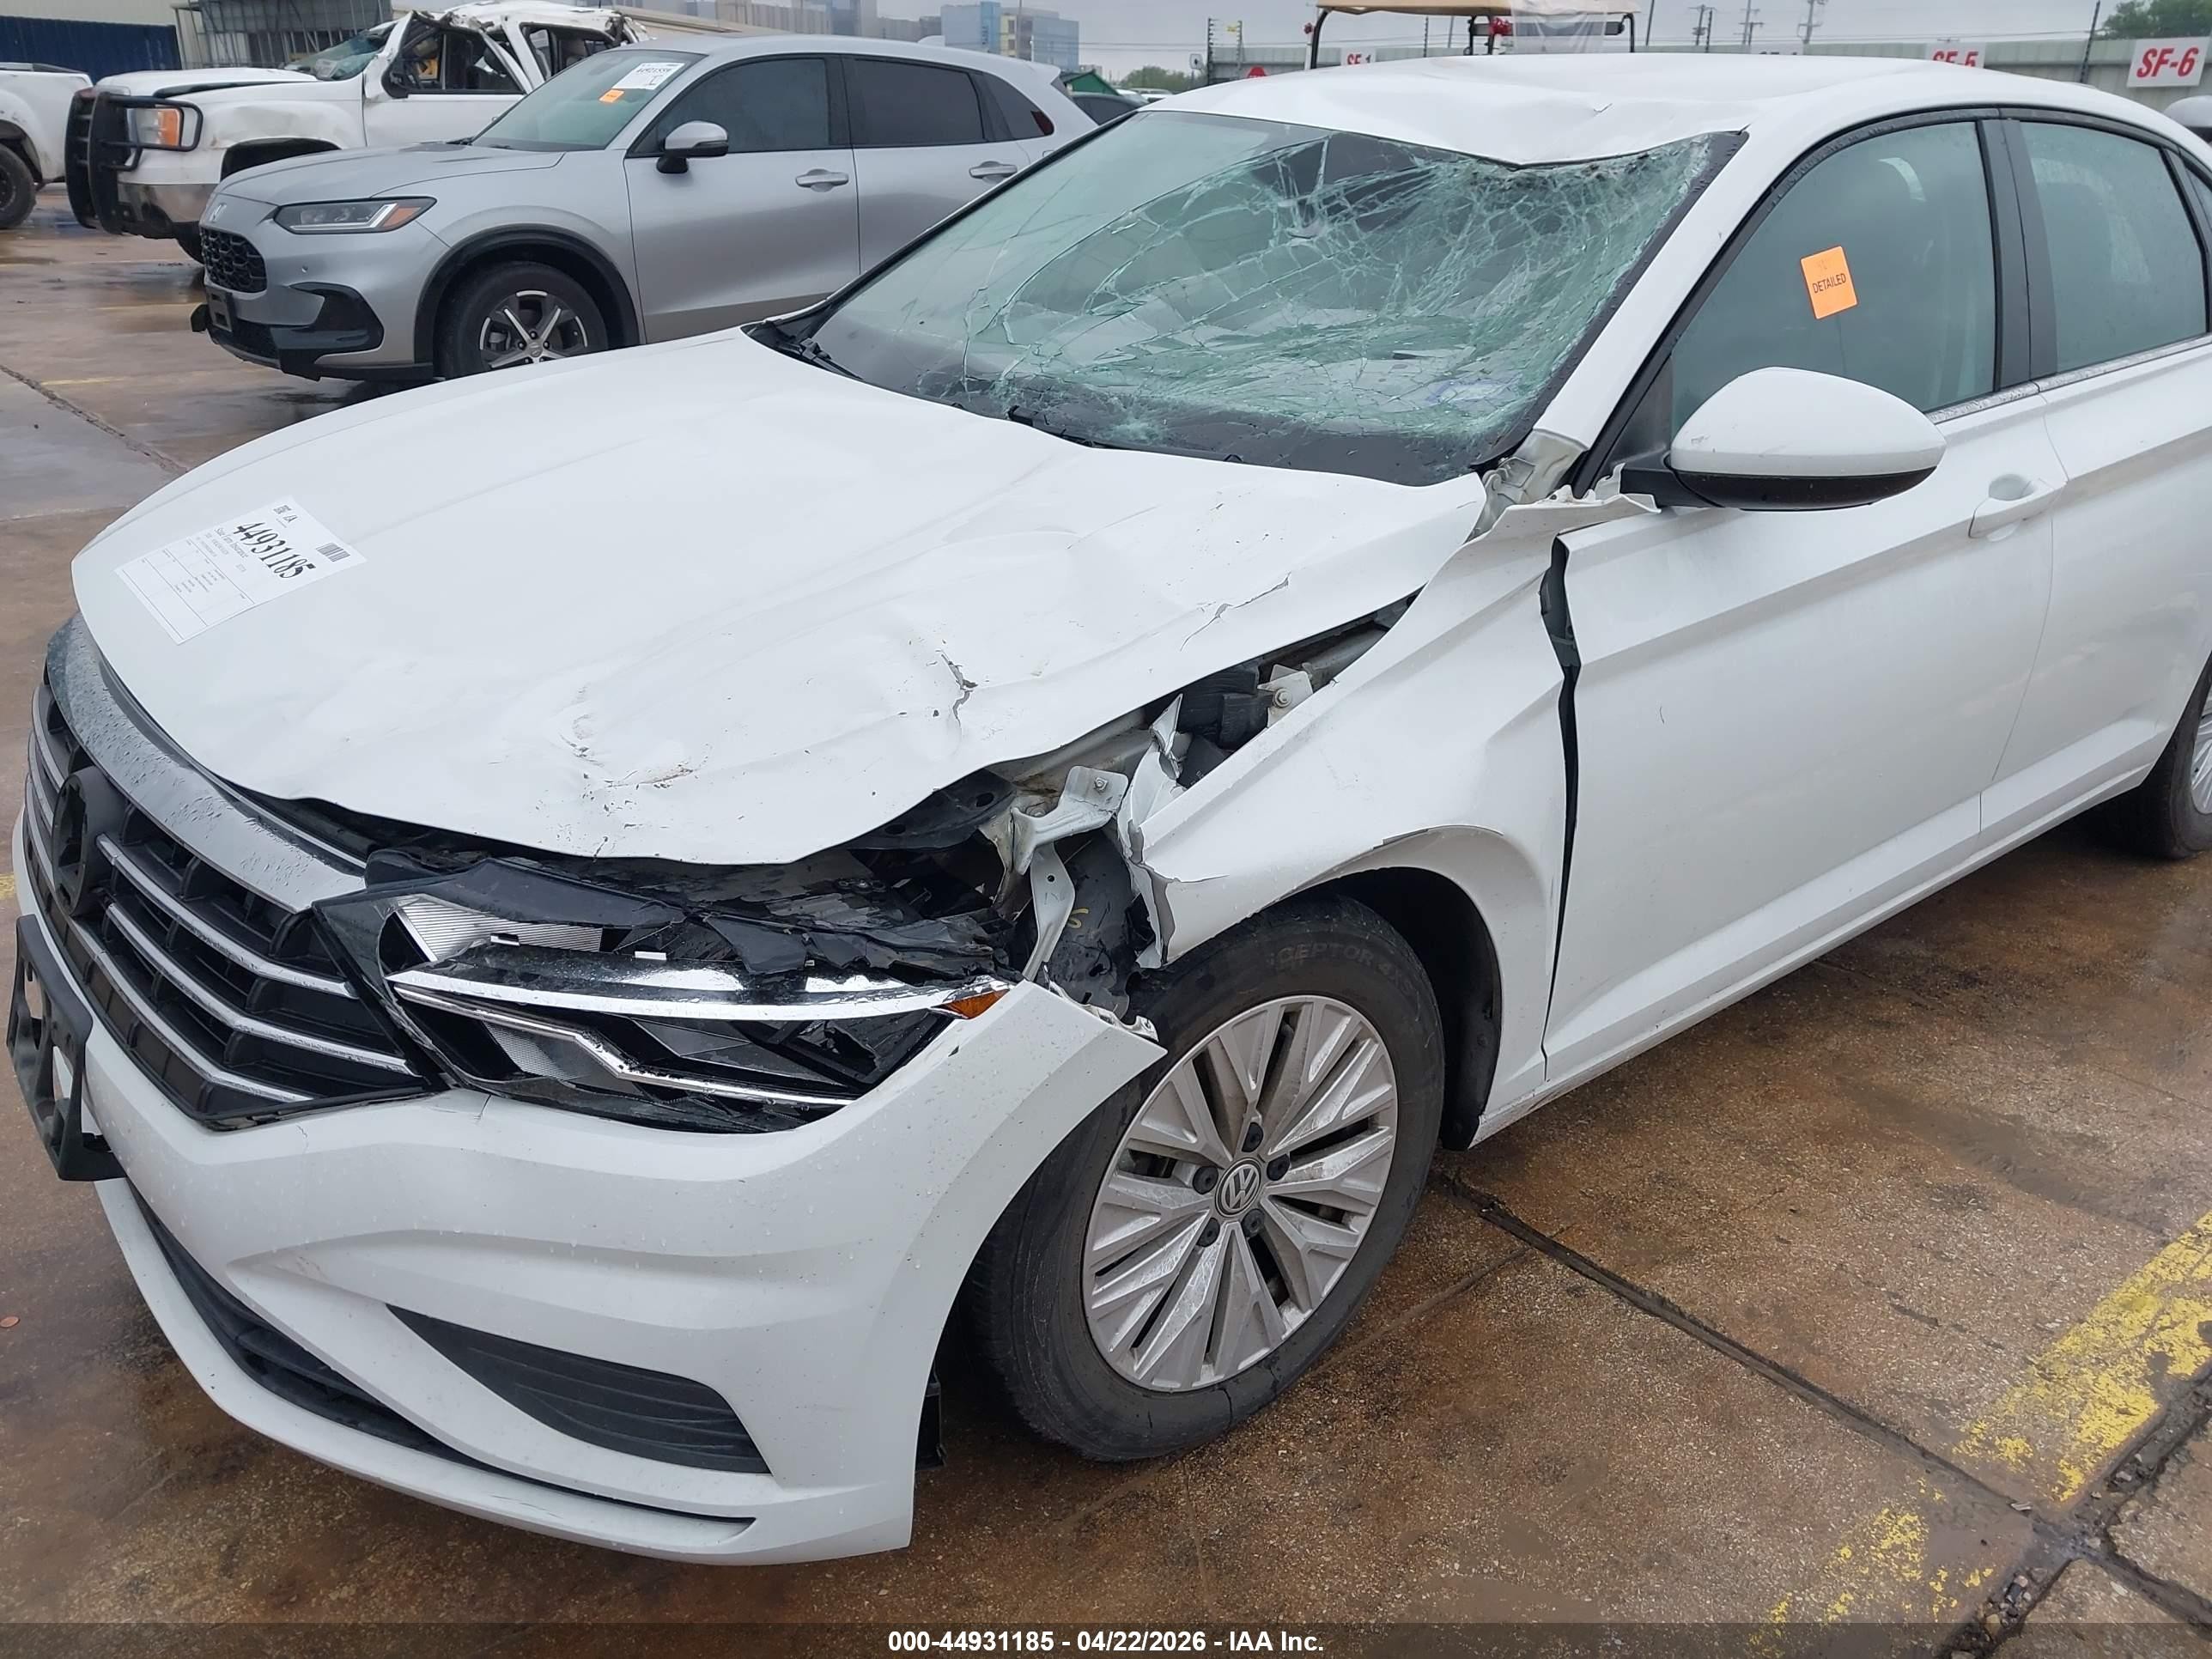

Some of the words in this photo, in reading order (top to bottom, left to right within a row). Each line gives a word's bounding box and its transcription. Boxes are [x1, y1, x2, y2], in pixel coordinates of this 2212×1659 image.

[2136, 46, 2200, 78] SF-6
[1812, 273, 1847, 294] DETAILED
[233, 521, 317, 579] 44931185
